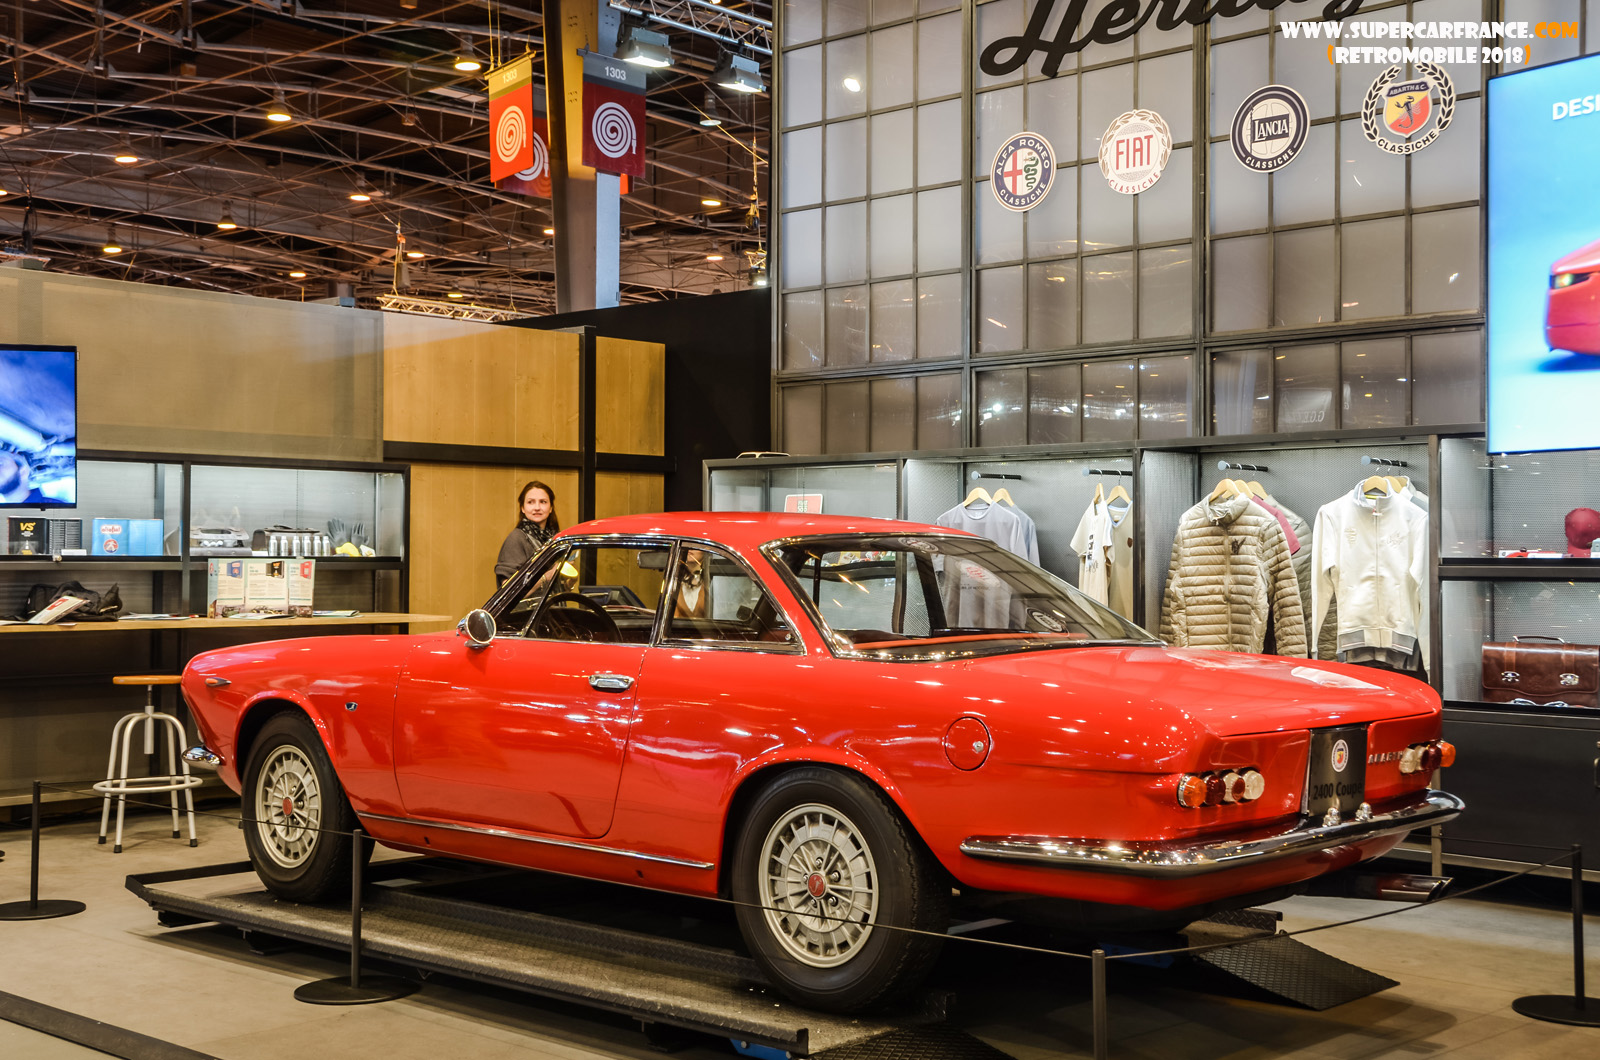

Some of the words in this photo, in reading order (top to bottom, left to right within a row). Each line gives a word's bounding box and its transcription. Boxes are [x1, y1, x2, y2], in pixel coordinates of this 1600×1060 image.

[502, 69, 518, 84] 1303
[604, 66, 627, 81] 1303
[1389, 85, 1415, 96] ABARTH
[1115, 134, 1154, 171] FIAT
[1377, 131, 1437, 153] CLASSICHE
[996, 145, 1015, 176] ALFA
[1019, 139, 1050, 169] ROMEO
[1245, 148, 1294, 169] CLASSICHE
[1000, 182, 1046, 205] CLASSICHE
[1108, 172, 1159, 194] CLASSICHE
[1313, 783, 1334, 800] 2400
[1336, 781, 1363, 798] Coupe
